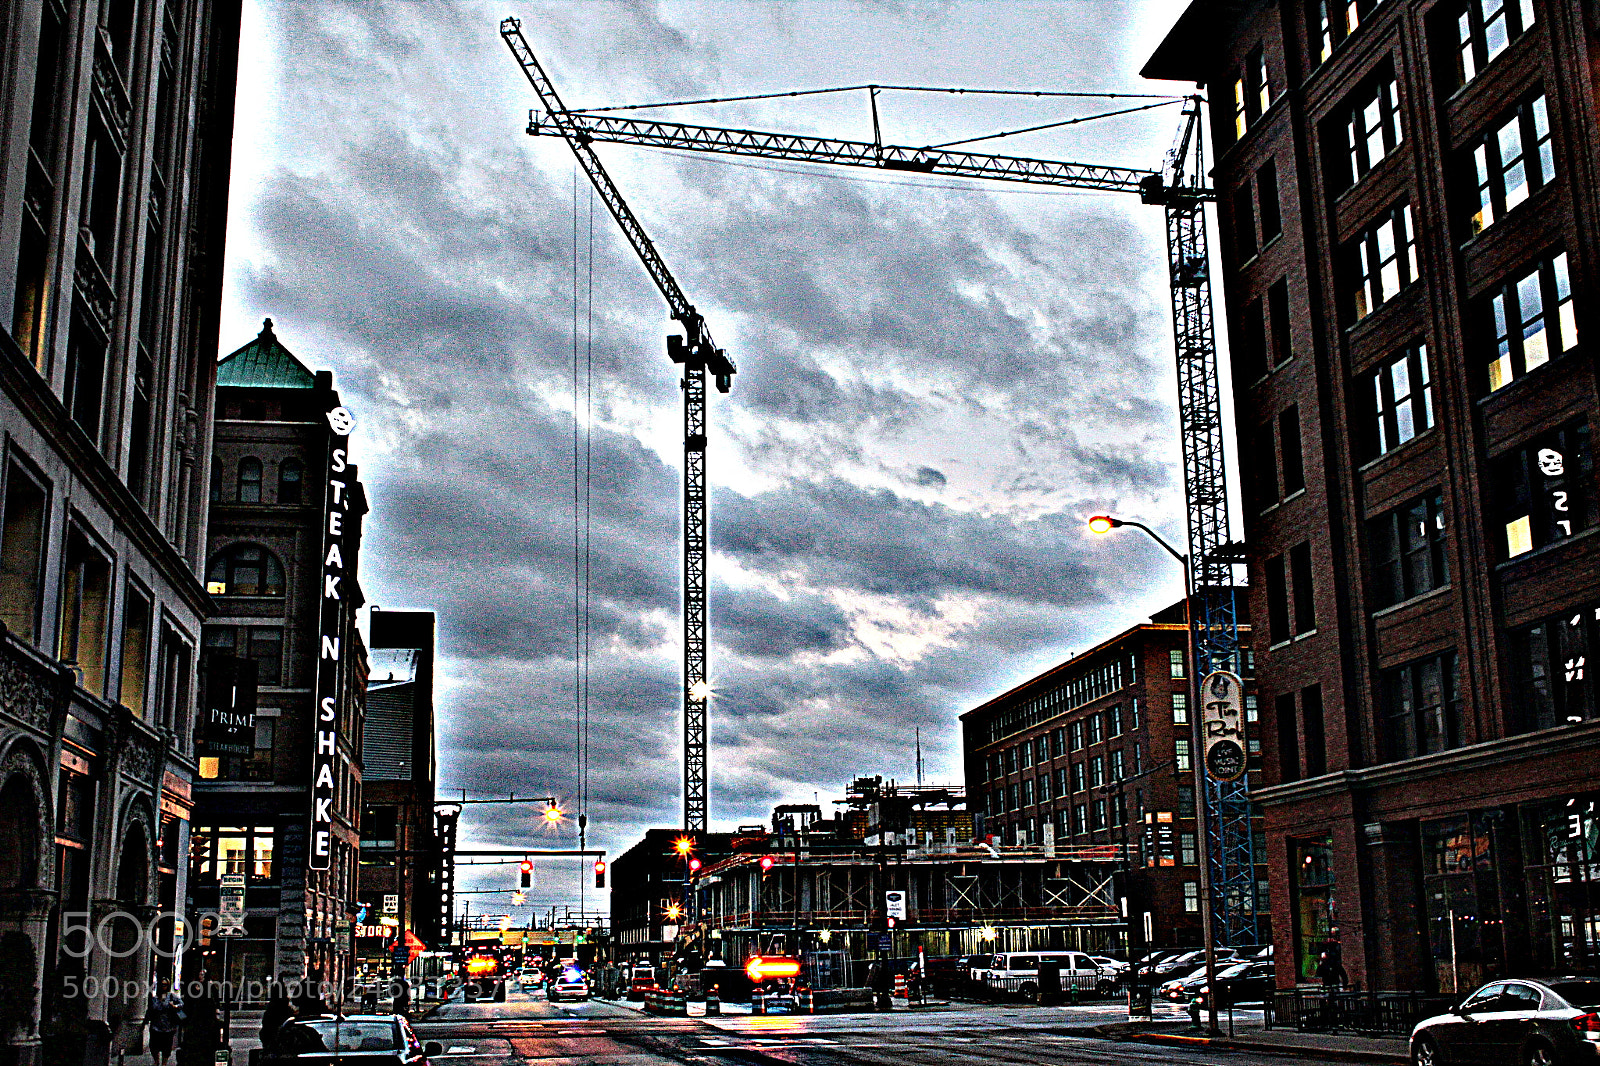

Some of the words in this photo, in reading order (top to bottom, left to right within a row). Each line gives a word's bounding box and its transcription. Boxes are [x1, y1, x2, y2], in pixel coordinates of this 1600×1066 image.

[325, 448, 346, 600] STEAK
[321, 635, 340, 661] N
[211, 708, 256, 728] PRIME
[315, 697, 336, 857] SHAKE
[354, 925, 392, 937] STOR
